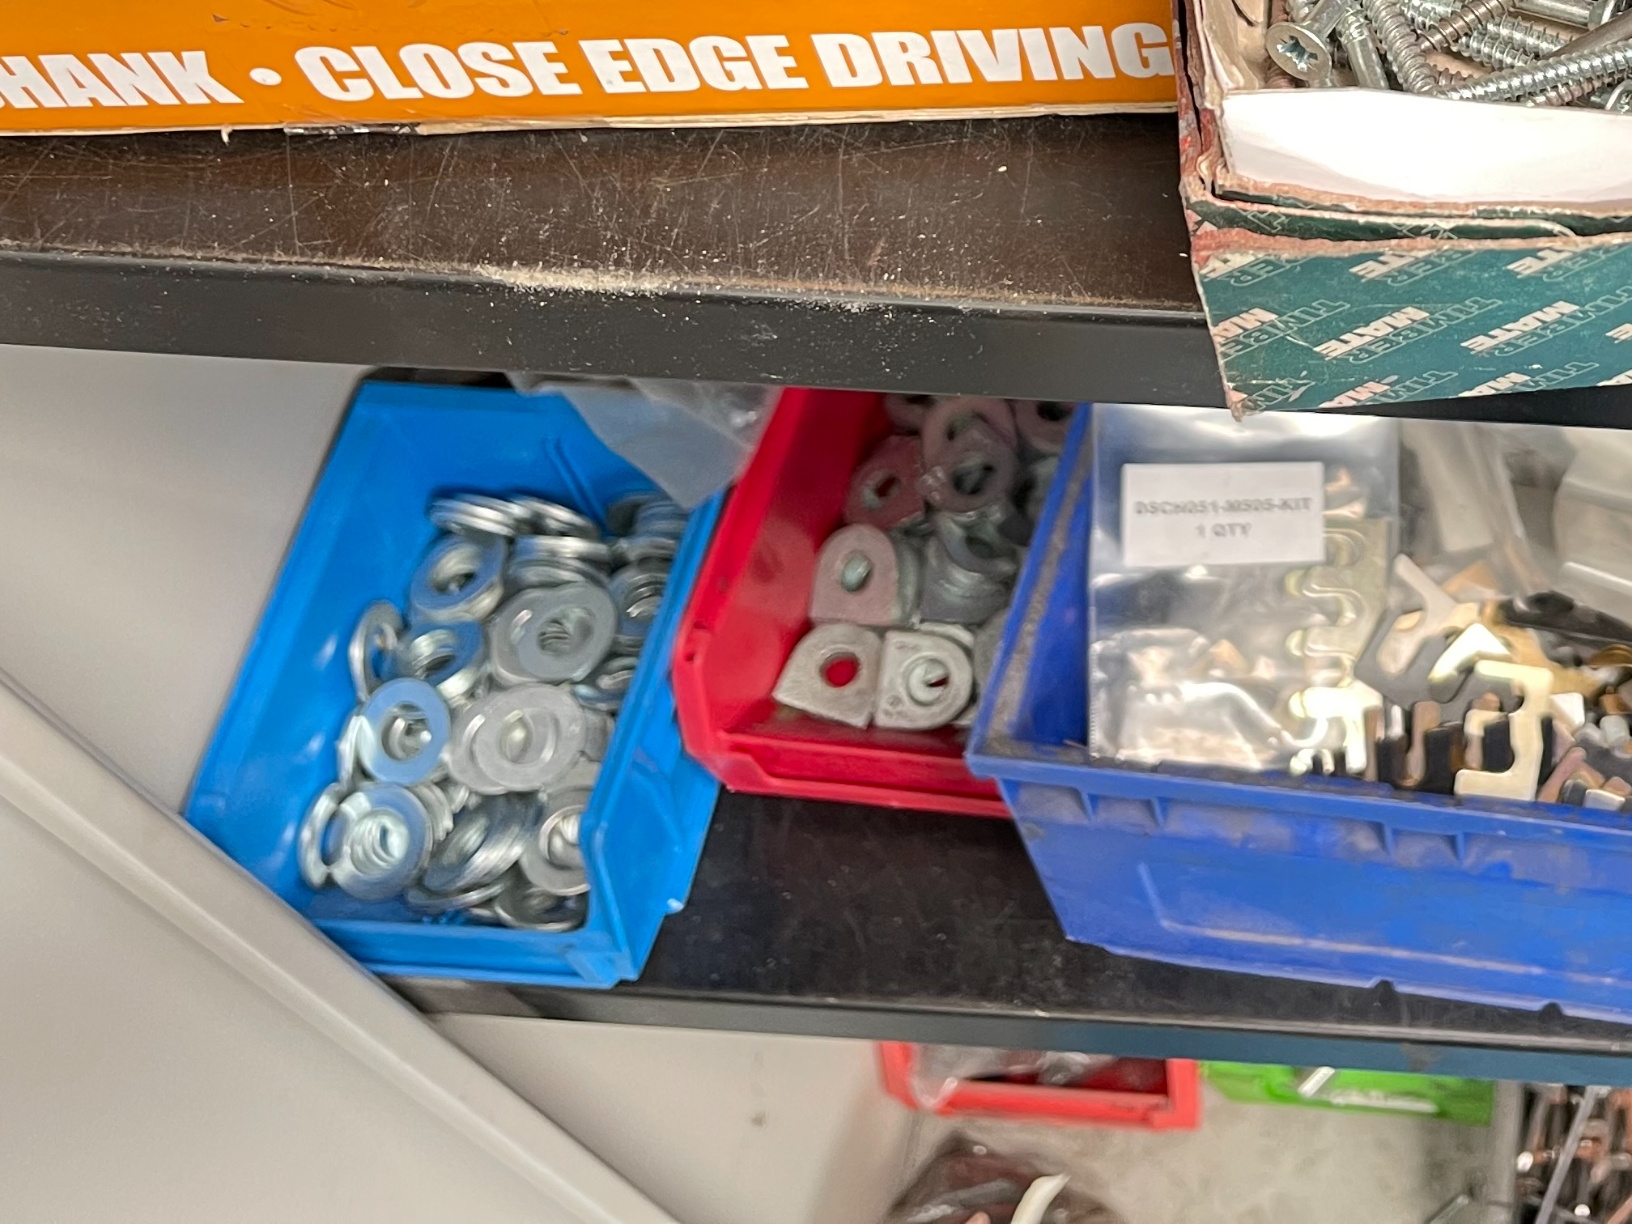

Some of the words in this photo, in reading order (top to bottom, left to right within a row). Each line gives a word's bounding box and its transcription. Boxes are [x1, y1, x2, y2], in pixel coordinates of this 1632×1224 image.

[0, 50, 245, 110] HANK
[293, 42, 583, 104] CLOSE
[578, 33, 810, 95] EDGE
[810, 21, 1176, 88] DRIVING
[1312, 305, 1431, 362] MATE
[1460, 300, 1581, 356] MATE
[1212, 523, 1253, 539] QTY
